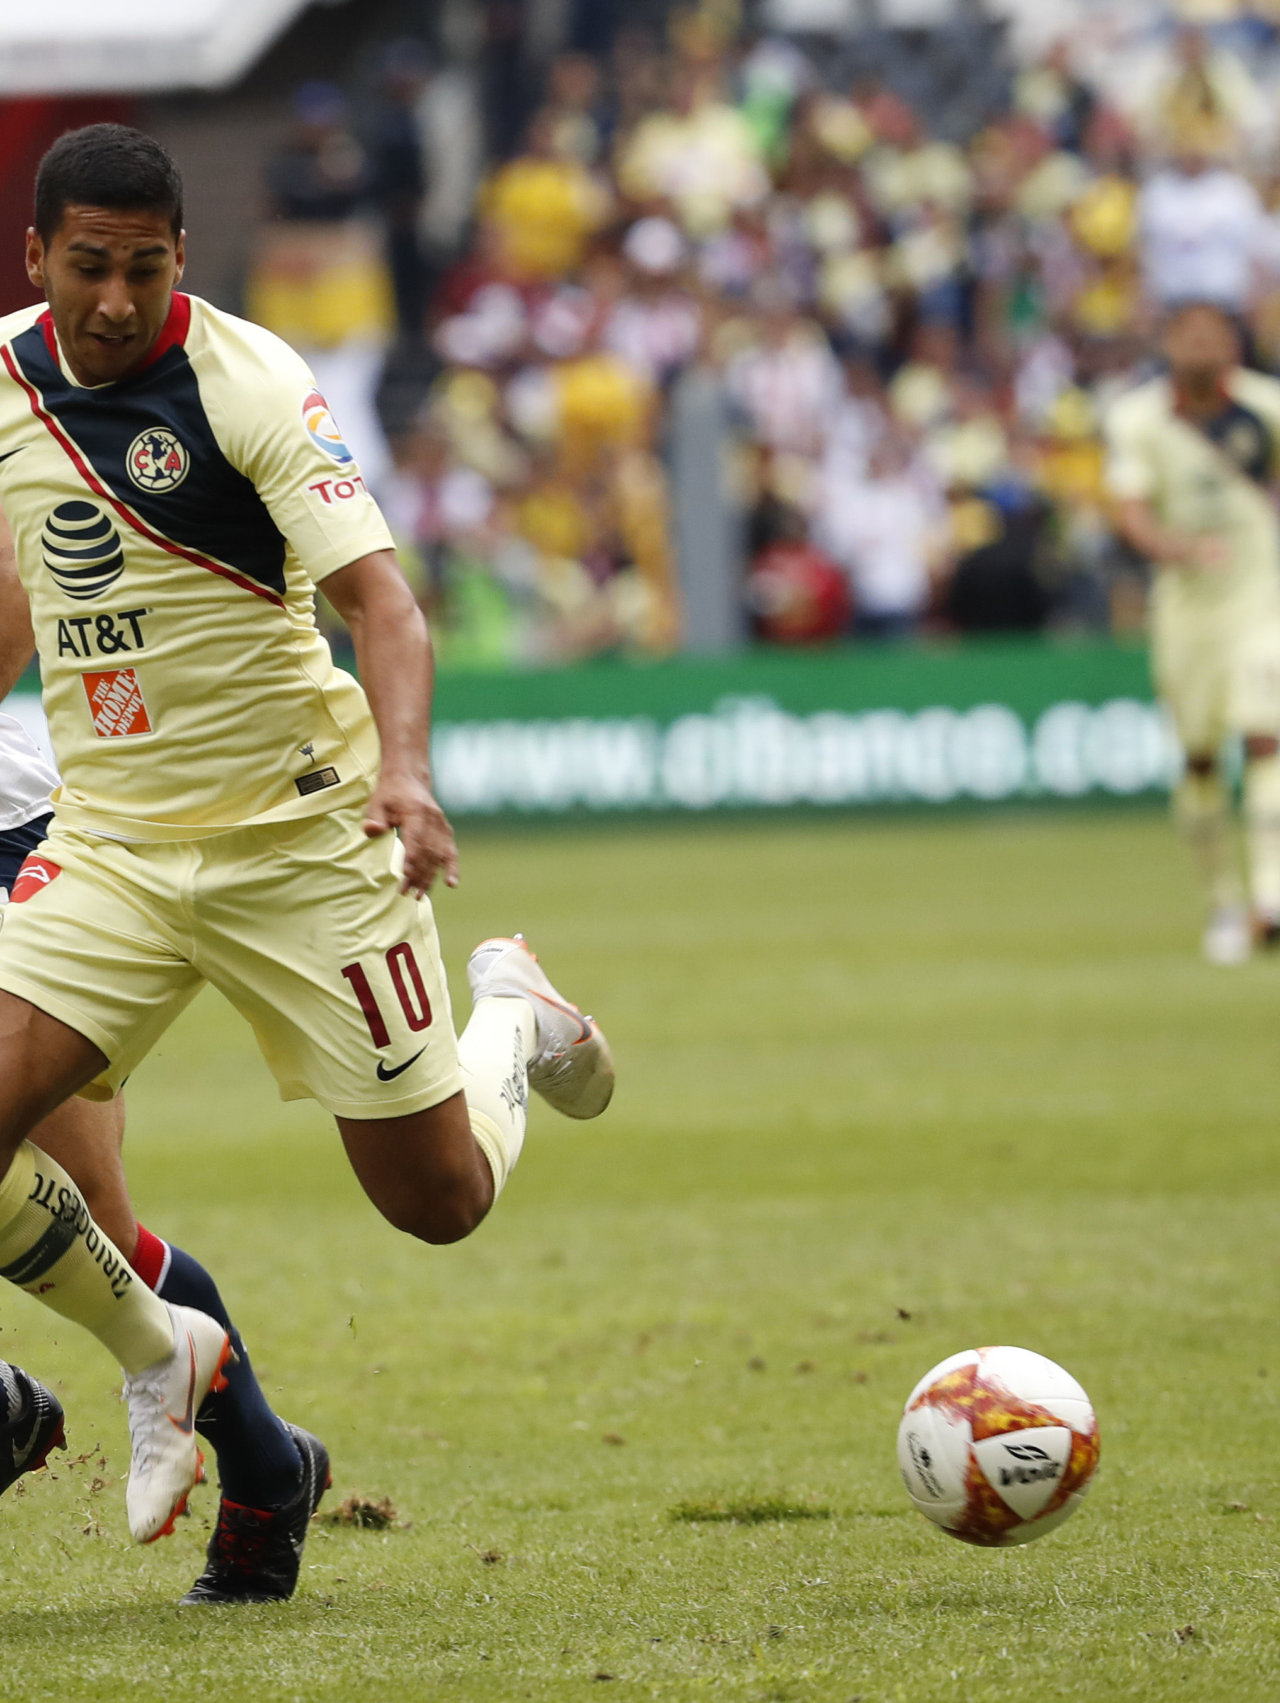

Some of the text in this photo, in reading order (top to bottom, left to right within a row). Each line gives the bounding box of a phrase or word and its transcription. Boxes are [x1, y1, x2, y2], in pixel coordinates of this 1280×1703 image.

[164, 449, 182, 471] A
[58, 608, 147, 657] AT&T
[91, 678, 111, 704] THE
[93, 669, 137, 736] HOME
[115, 692, 144, 736] DEPOT
[341, 941, 432, 1049] 10
